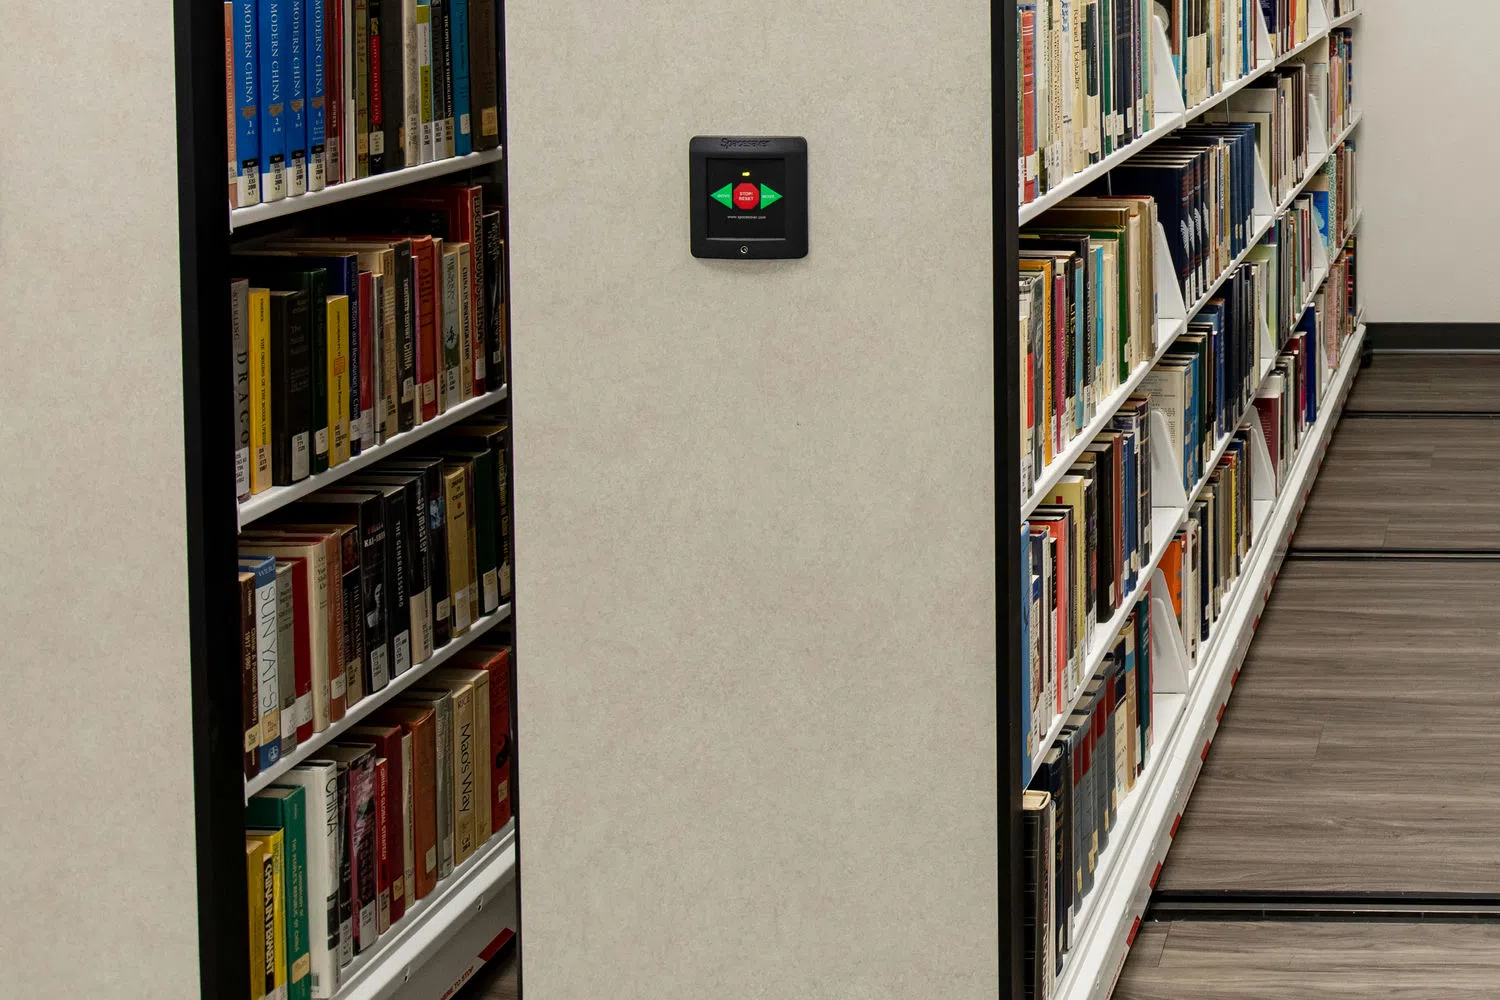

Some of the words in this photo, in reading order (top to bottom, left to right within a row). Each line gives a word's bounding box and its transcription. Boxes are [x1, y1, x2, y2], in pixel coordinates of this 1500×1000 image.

[245, 62, 253, 103] CHINA
[260, 586, 276, 638] SUN
[460, 775, 473, 812] Way
[264, 864, 273, 905] CHINA
[265, 908, 273, 923] IN
[265, 925, 274, 976] FERMENT
